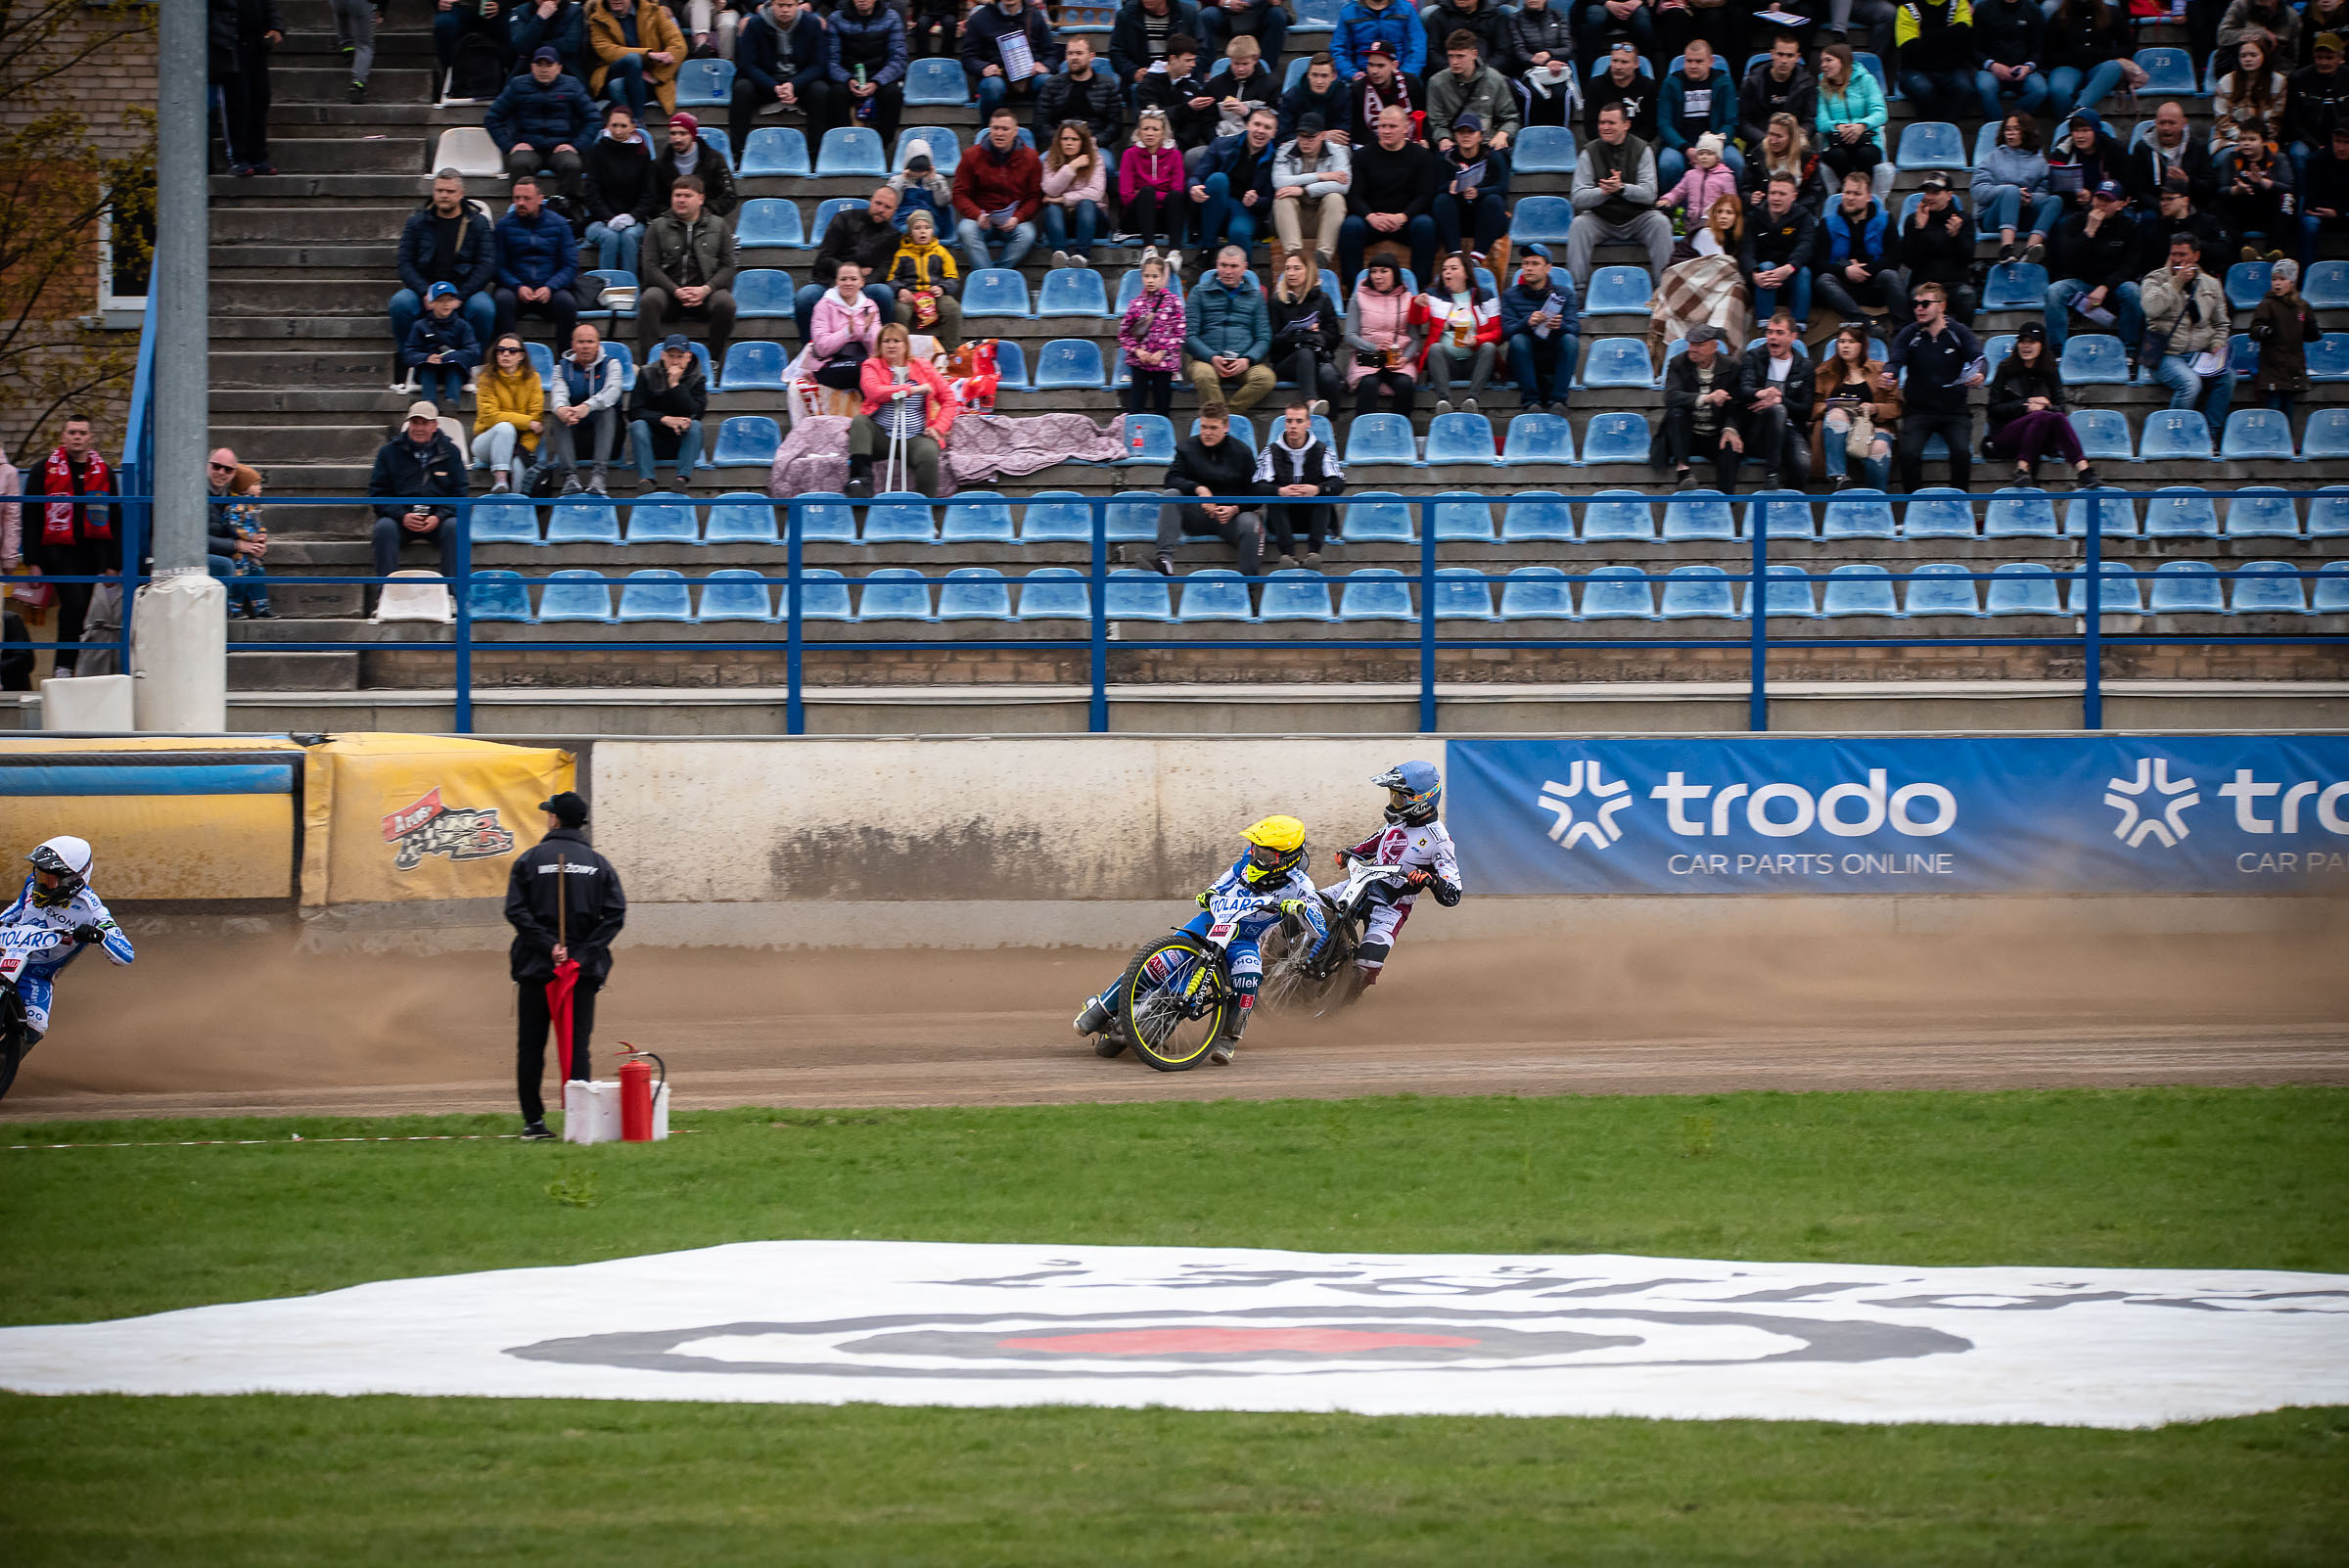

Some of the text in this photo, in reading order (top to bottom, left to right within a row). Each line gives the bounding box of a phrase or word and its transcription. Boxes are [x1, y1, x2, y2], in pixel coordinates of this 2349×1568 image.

[1649, 768, 1958, 837] trodo
[1667, 853, 1955, 875] CAR PARTS ONLINE
[2236, 852, 2349, 874] CAR PA
[1233, 977, 1259, 989] Mlek
[27, 1010, 43, 1021] OG
